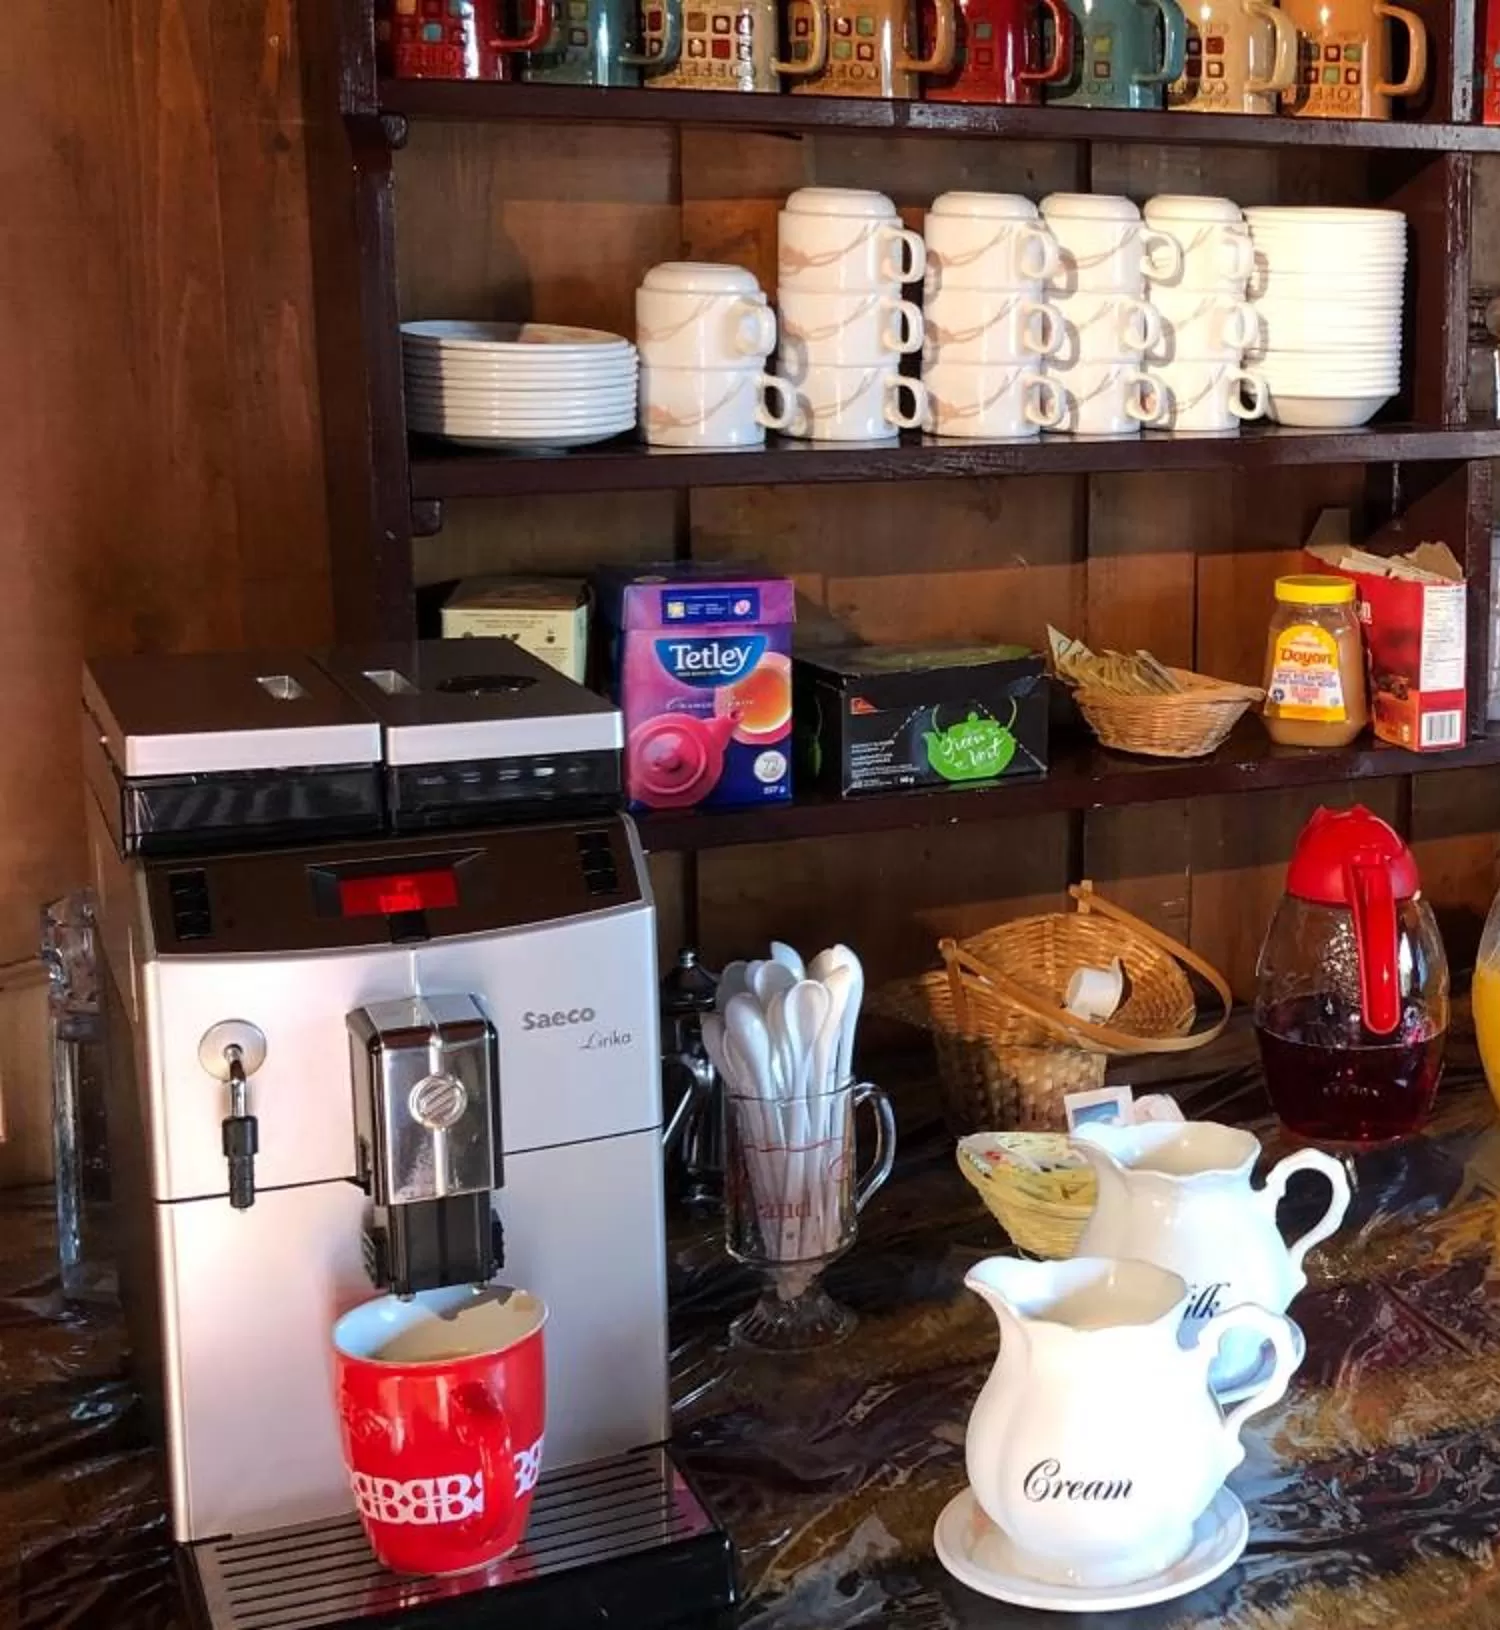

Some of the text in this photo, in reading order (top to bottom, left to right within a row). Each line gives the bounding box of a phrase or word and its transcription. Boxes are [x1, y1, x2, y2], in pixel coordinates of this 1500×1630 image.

[668, 641, 752, 676] Tetley
[522, 1007, 596, 1031] Saeco
[578, 1028, 632, 1050] Lirika
[1183, 1282, 1231, 1321] ilk
[1022, 1457, 1133, 1502] Cream
